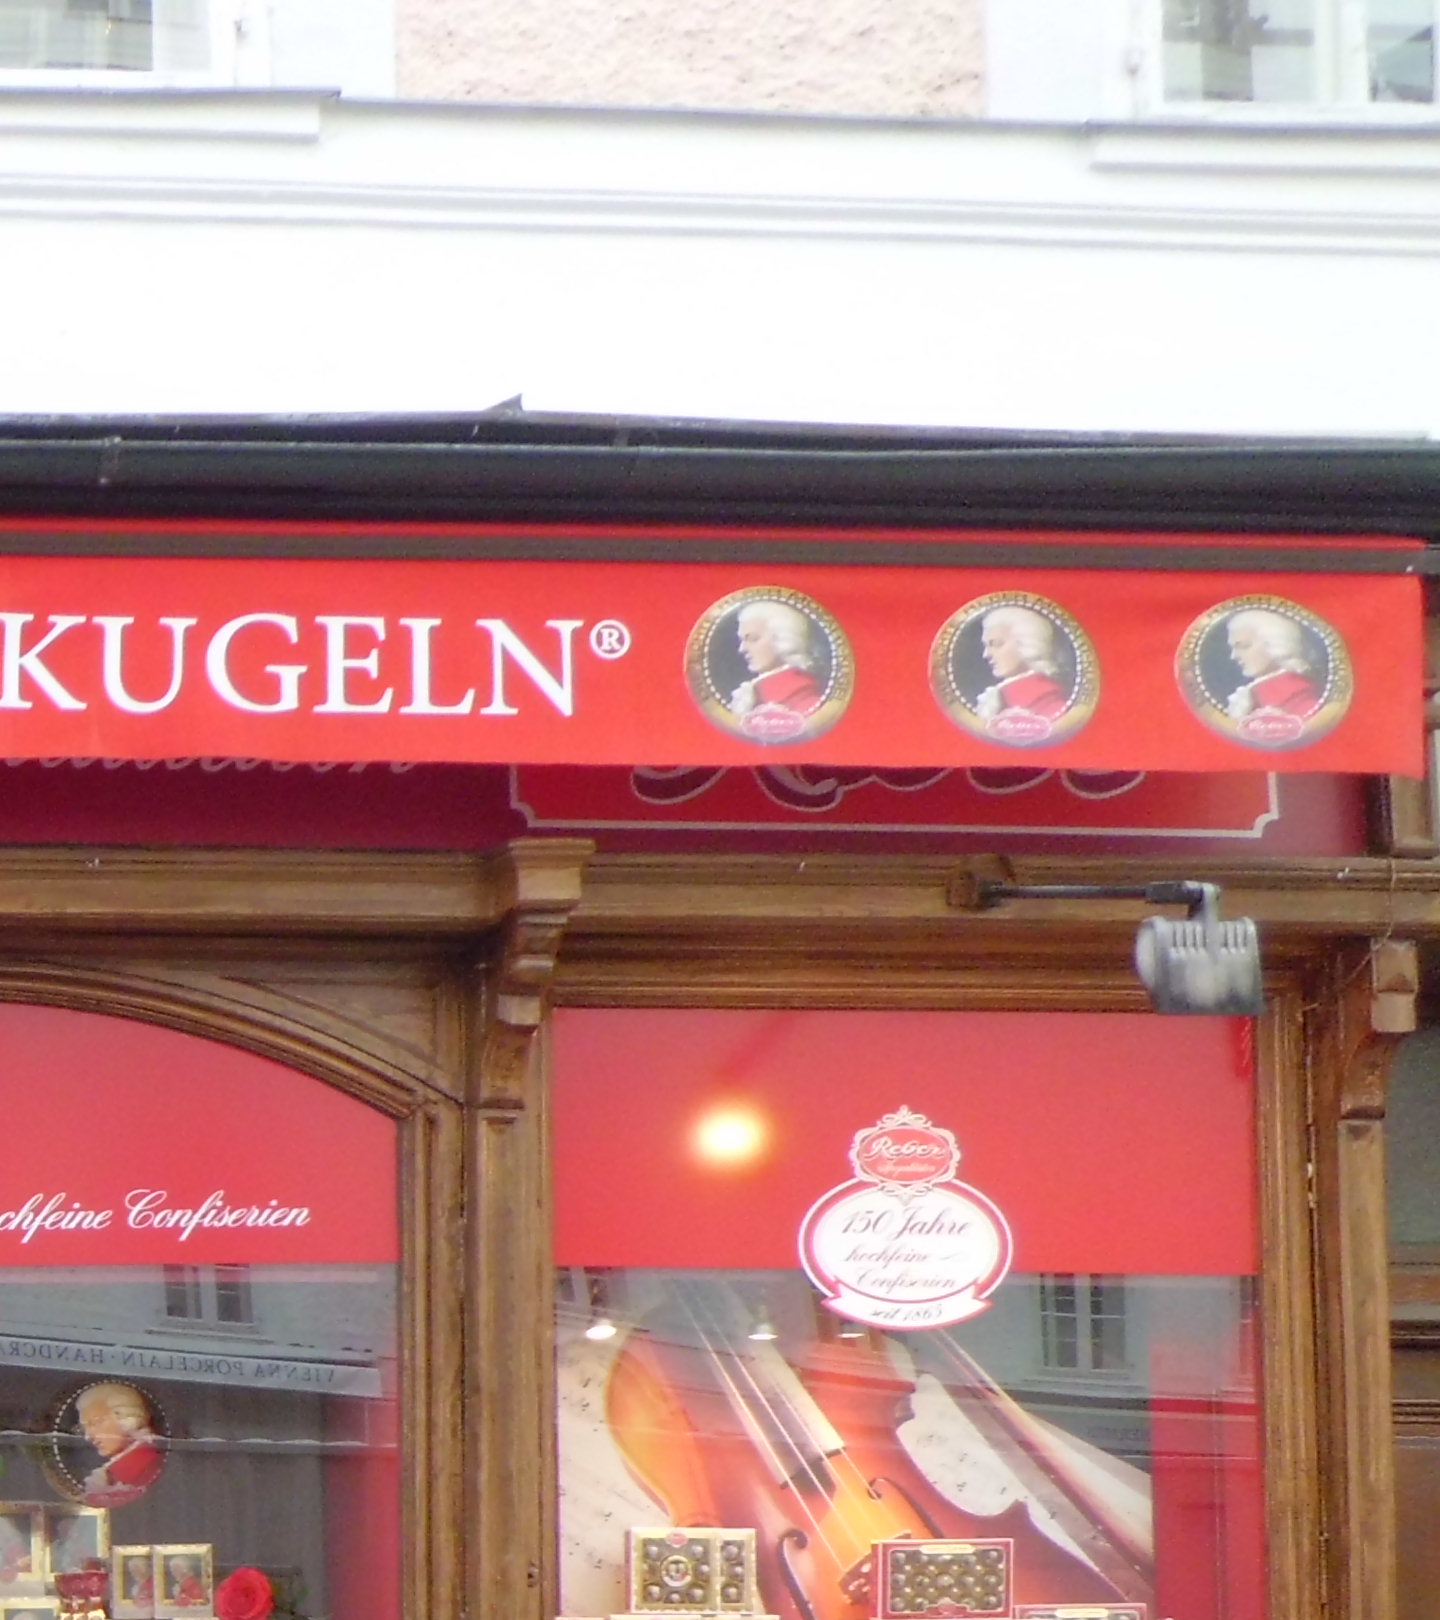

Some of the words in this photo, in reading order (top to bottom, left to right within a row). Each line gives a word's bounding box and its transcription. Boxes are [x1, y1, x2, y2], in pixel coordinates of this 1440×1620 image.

[864, 1136, 945, 1161] Reber
[124, 1188, 311, 1242] Confiserien
[841, 1209, 894, 1234] 150
[890, 1206, 973, 1241] Jahre
